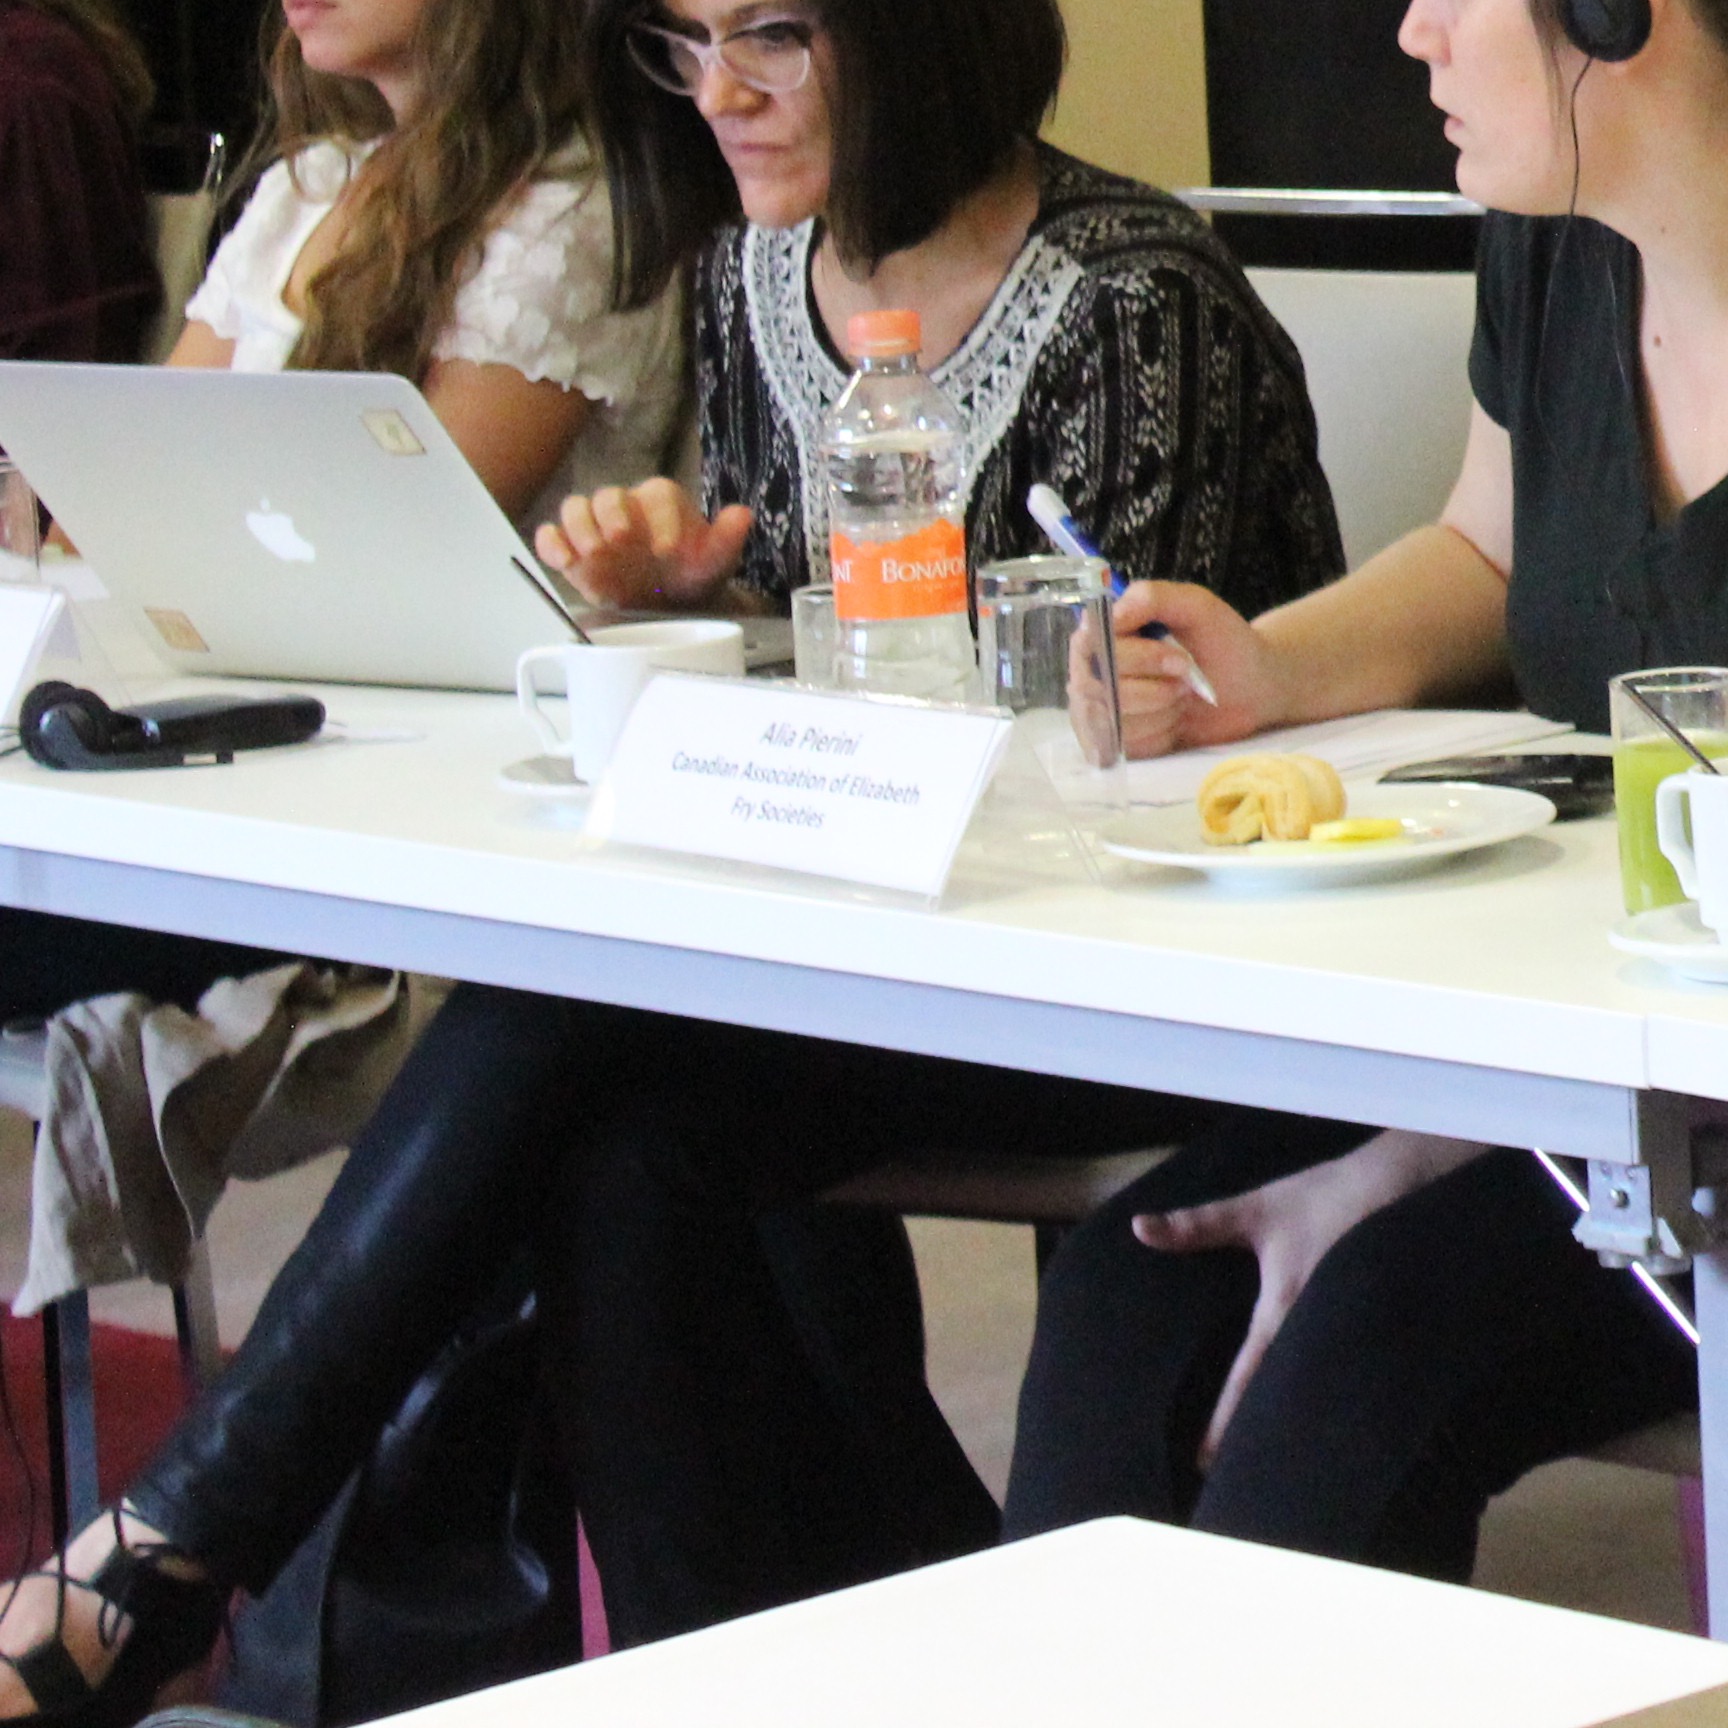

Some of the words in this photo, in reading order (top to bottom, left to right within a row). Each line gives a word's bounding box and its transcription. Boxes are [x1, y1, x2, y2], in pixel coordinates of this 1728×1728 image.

[761, 722, 796, 747] Alia
[799, 727, 859, 756] Pierini
[671, 751, 740, 780] Canadian
[742, 759, 827, 793] Association
[829, 772, 848, 793] of
[849, 776, 920, 805] Elizabeth
[731, 796, 755, 821] Fry
[758, 799, 825, 829] Societies
